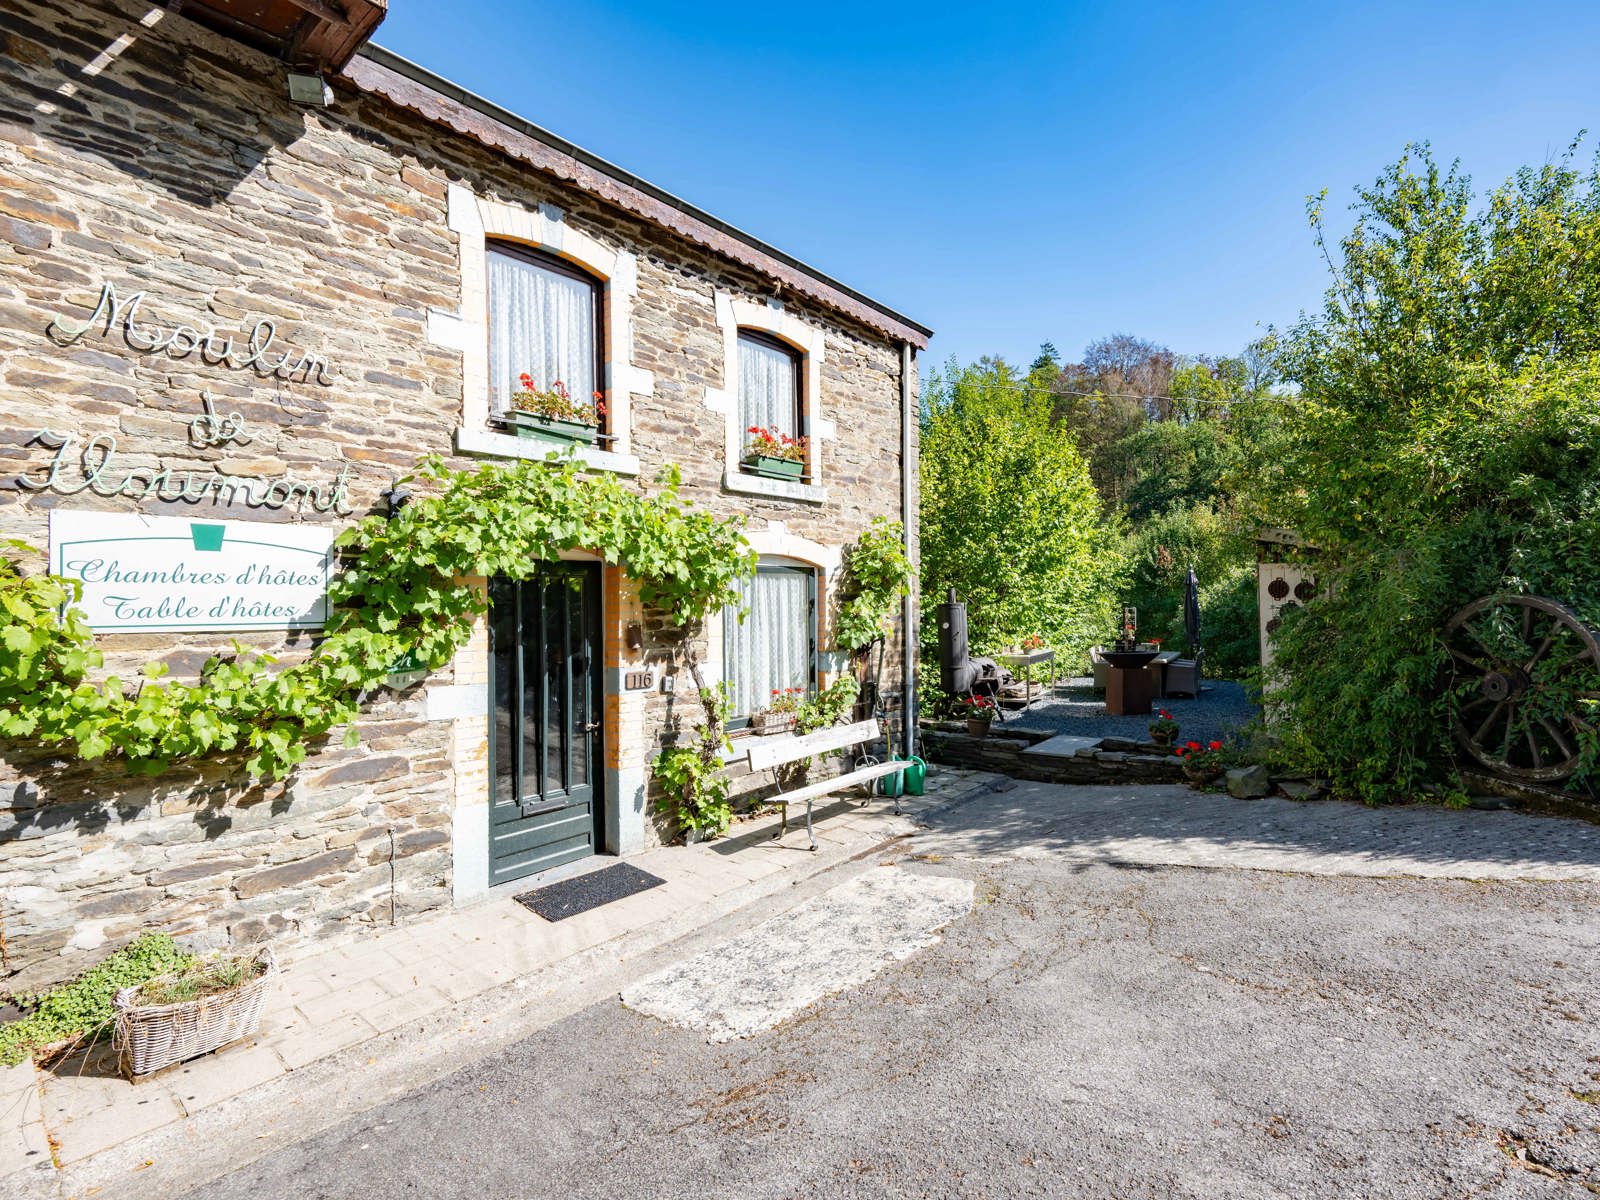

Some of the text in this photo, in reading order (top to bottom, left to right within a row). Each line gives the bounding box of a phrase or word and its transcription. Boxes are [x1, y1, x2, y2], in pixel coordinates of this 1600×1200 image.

[54, 280, 339, 381] Moulin
[193, 386, 262, 442] de
[66, 558, 323, 587] Chambres d'hôtes
[102, 595, 300, 620] Table d'hôtes
[632, 673, 652, 689] 116
